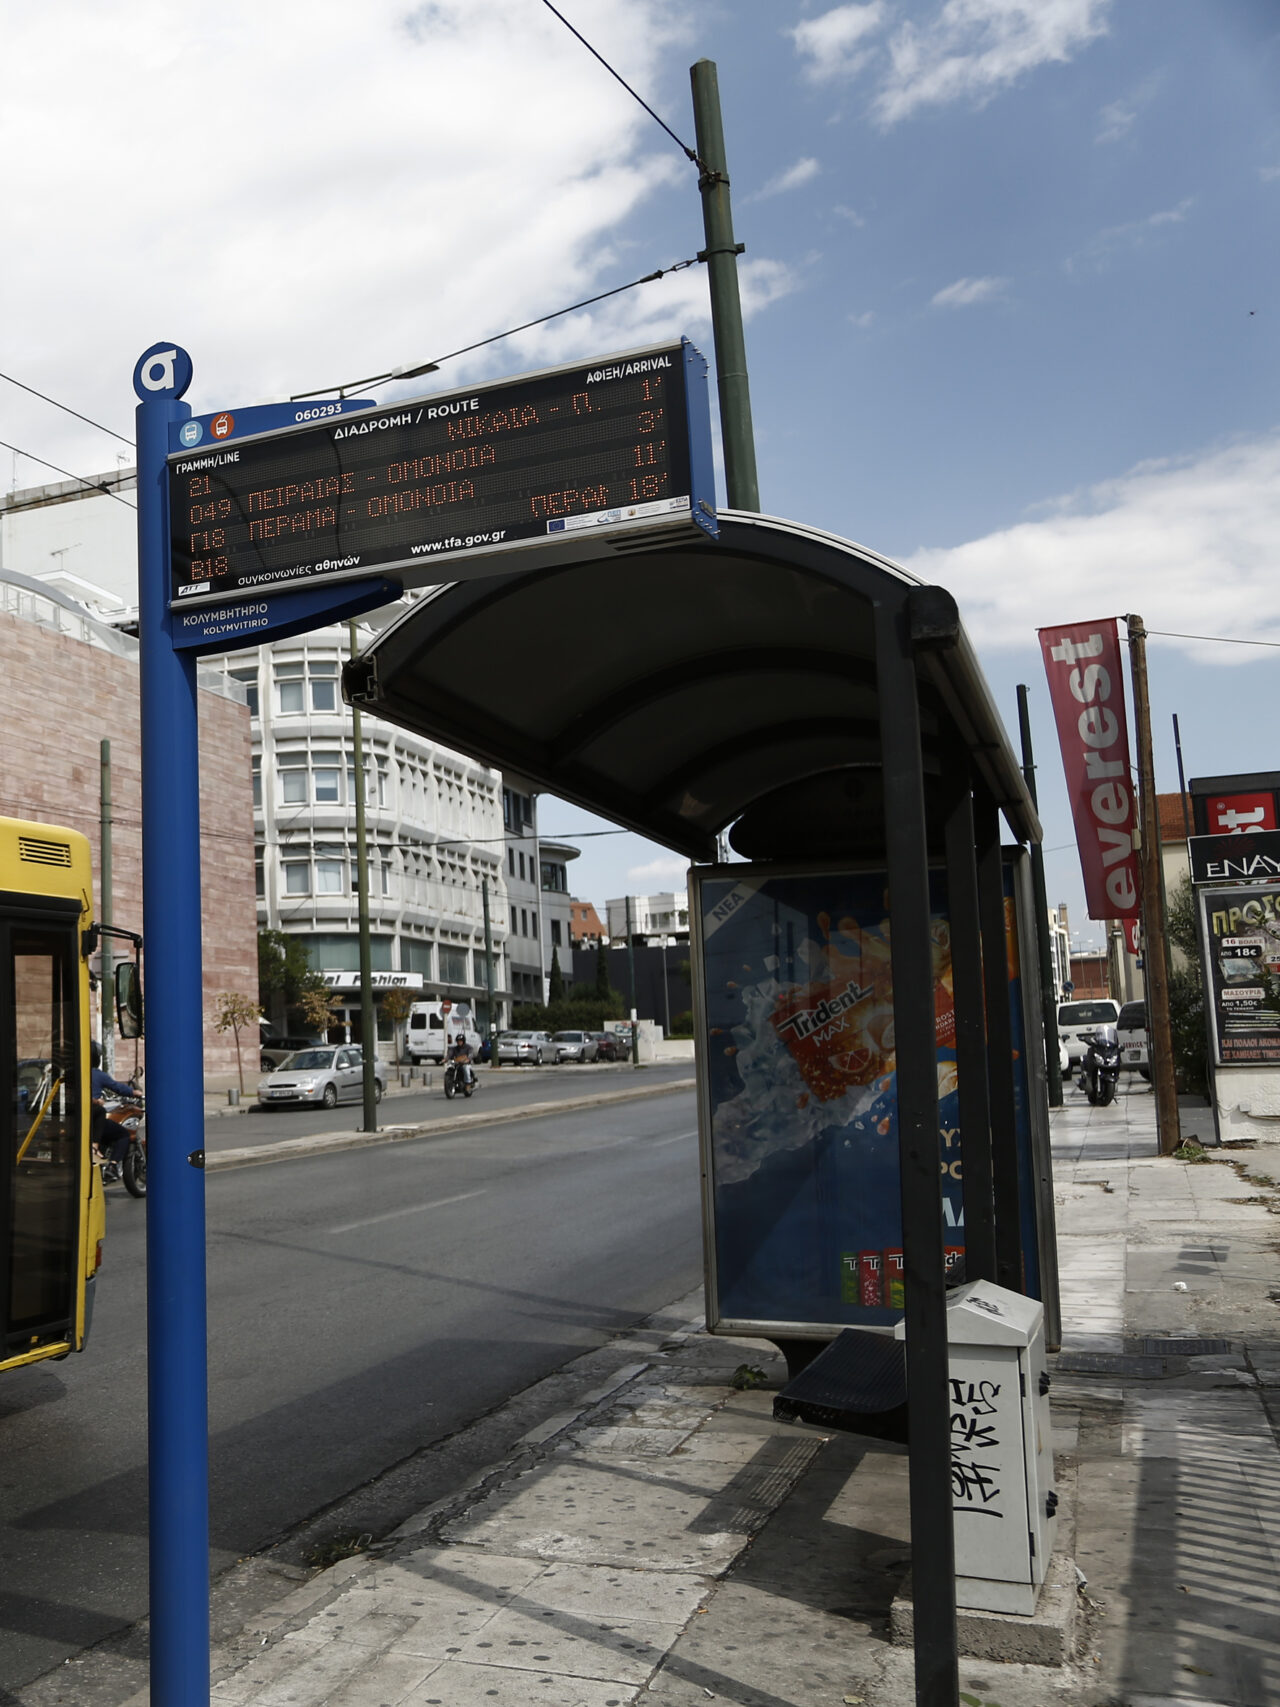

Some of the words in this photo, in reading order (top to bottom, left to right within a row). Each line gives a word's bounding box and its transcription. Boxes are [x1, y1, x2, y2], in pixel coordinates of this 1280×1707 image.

[295, 403, 342, 422] 060293
[334, 413, 412, 439] ΔΙΑΔΡΟΜΗ
[428, 398, 480, 420] ROUTE
[176, 451, 240, 474] ΓΡΑΜΜΗ/LINE
[189, 475, 211, 497] 21
[190, 498, 231, 525] 049
[248, 472, 355, 512] ΠΕΙΡΑΙΑΣ
[387, 444, 495, 483] ΟΜΟΝΟΙΑ
[249, 506, 335, 541] ΠΕΡΑΜΑ
[368, 479, 474, 517] ΟΜΟΝΟΙΑ
[411, 530, 506, 554] www.tfa.gov.gr
[238, 564, 312, 585] συγκοινωνίες
[315, 555, 360, 572] αθηνών
[183, 603, 268, 626] ΚΟΛΥΜΒΗΤΗΡΙΟ
[203, 617, 269, 635] KOLYMVITIRIO
[1050, 633, 1138, 909] everest
[1212, 894, 1280, 937] ΠΡΟΣ
[1235, 948, 1257, 957] 18€
[352, 975, 407, 985] Fshion
[775, 980, 875, 1040] Trident
[812, 1016, 851, 1047] MAX
